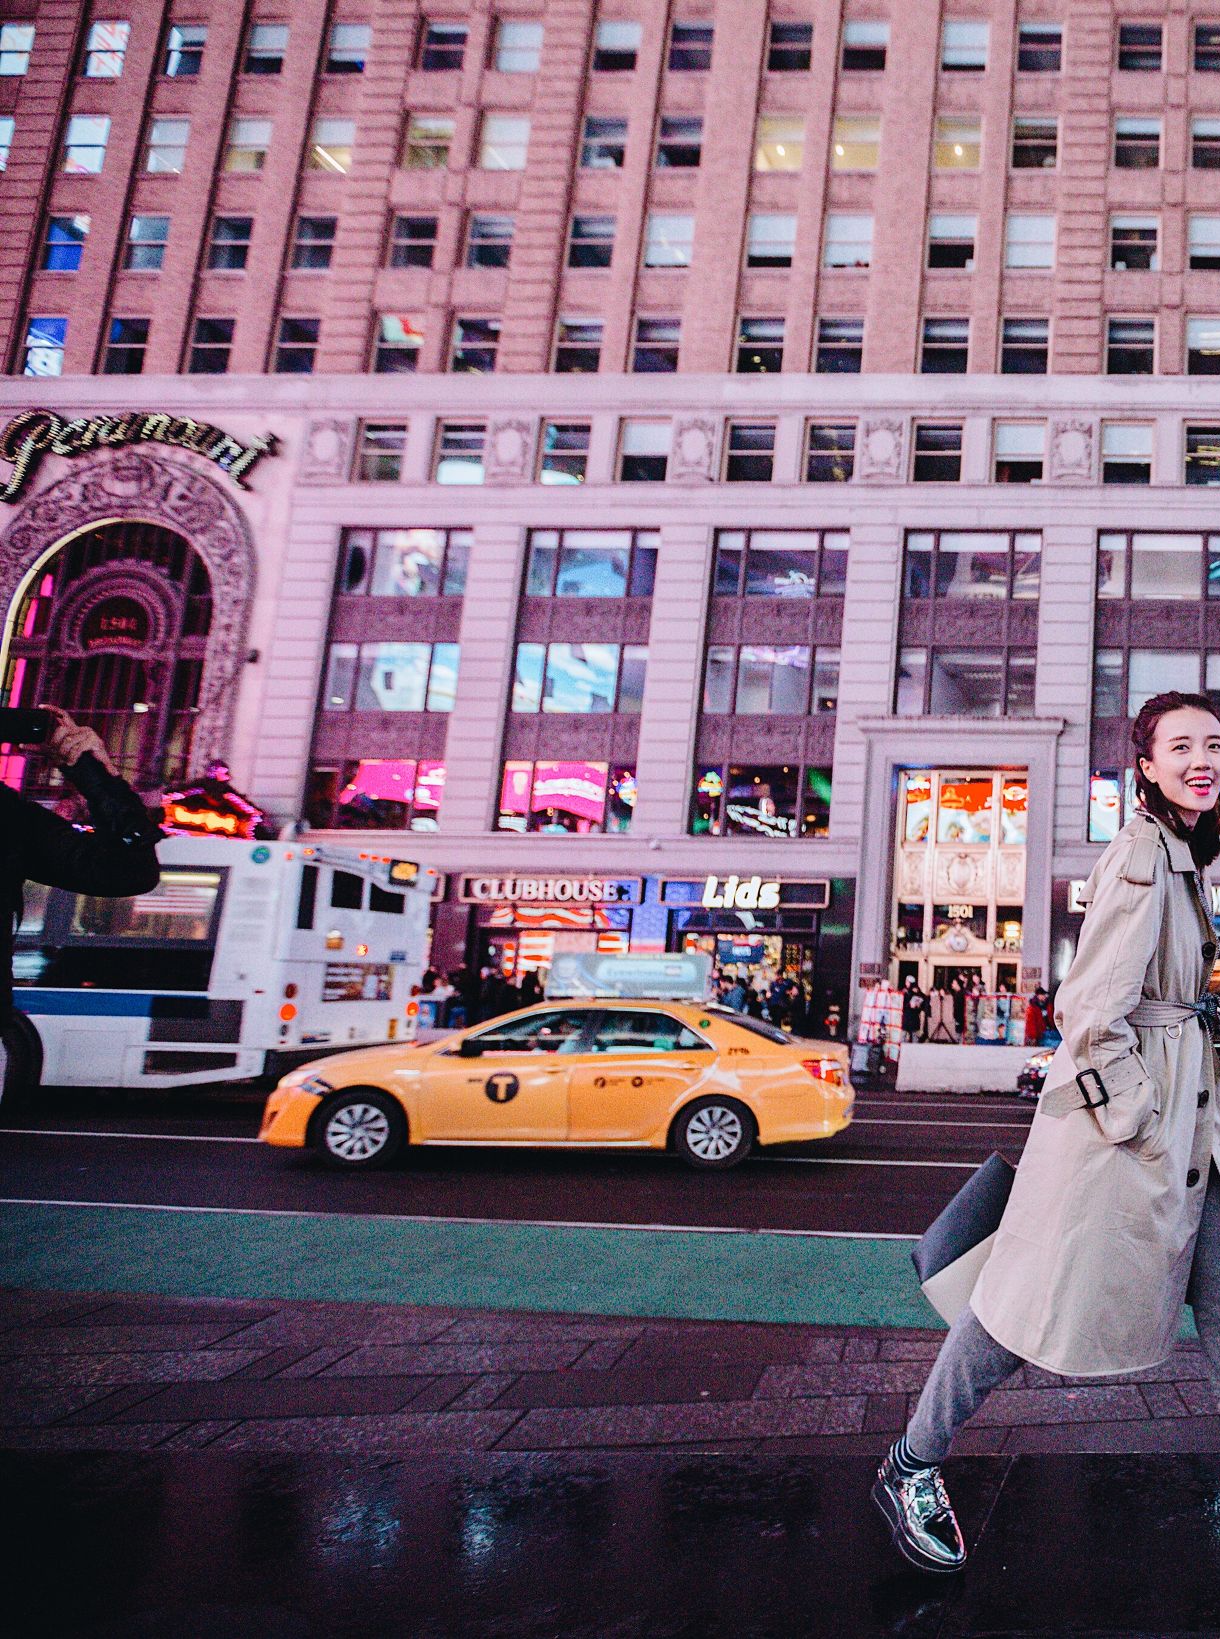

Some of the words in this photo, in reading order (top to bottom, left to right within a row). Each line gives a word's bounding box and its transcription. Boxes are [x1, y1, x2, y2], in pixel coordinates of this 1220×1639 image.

[472, 878, 619, 902] CLUBHOUSE
[702, 875, 781, 909] Lids
[948, 904, 974, 919] 1501
